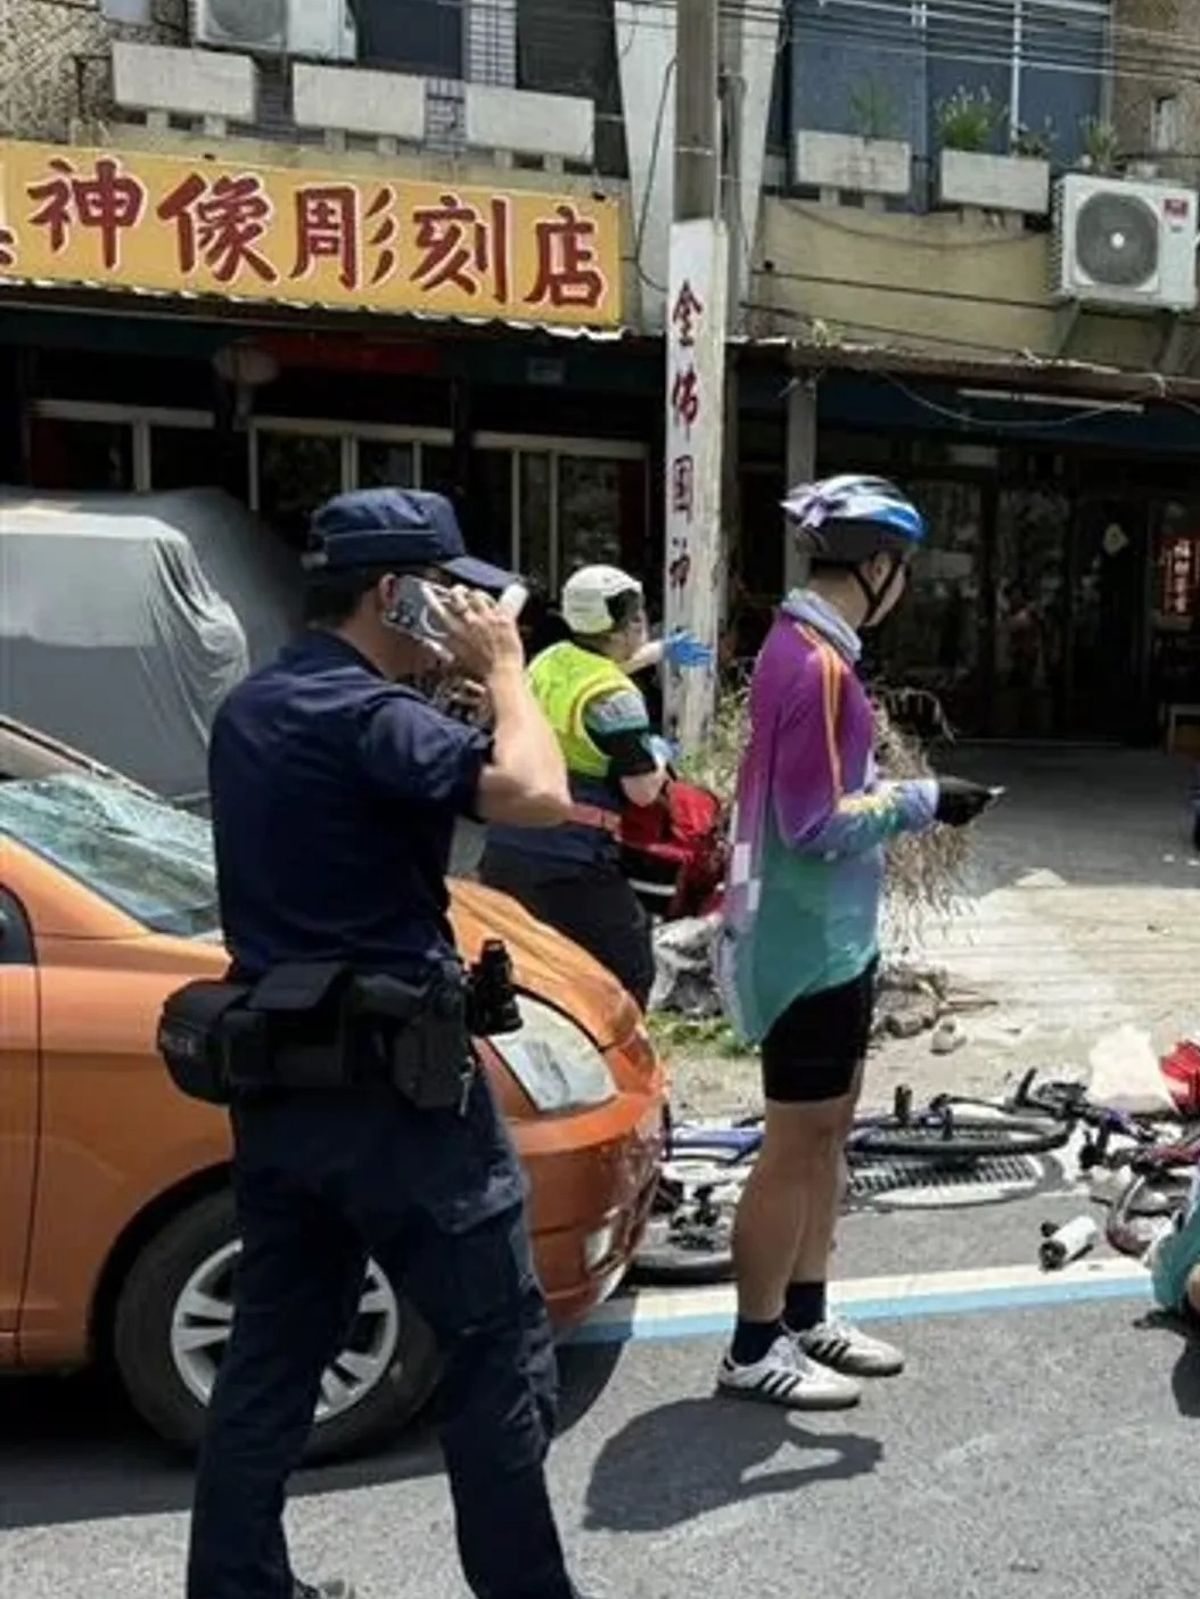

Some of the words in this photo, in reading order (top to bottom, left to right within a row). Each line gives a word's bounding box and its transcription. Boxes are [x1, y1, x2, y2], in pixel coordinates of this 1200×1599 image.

[0, 159, 605, 309] 神像彫刻店
